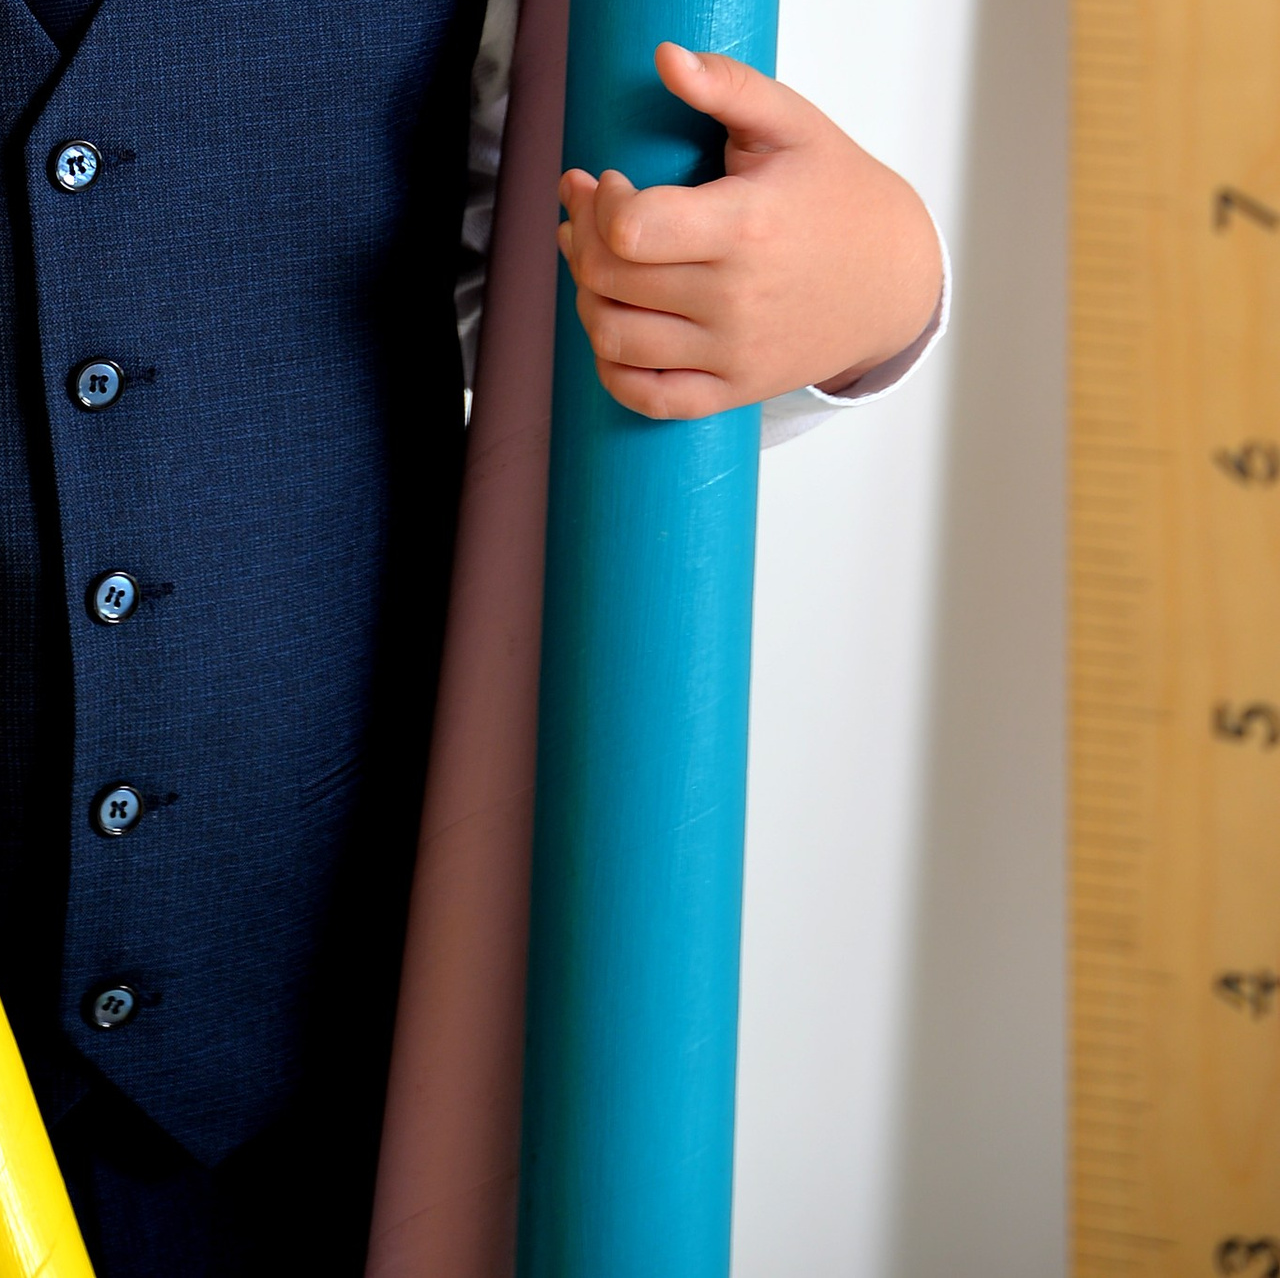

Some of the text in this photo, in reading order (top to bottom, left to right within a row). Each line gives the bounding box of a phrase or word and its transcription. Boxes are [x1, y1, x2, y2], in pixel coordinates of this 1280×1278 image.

[1215, 187, 1280, 233] 7
[1215, 439, 1280, 486] 6
[1214, 701, 1280, 749] 5
[1215, 967, 1280, 1018] 4
[1216, 1236, 1280, 1278] 3
